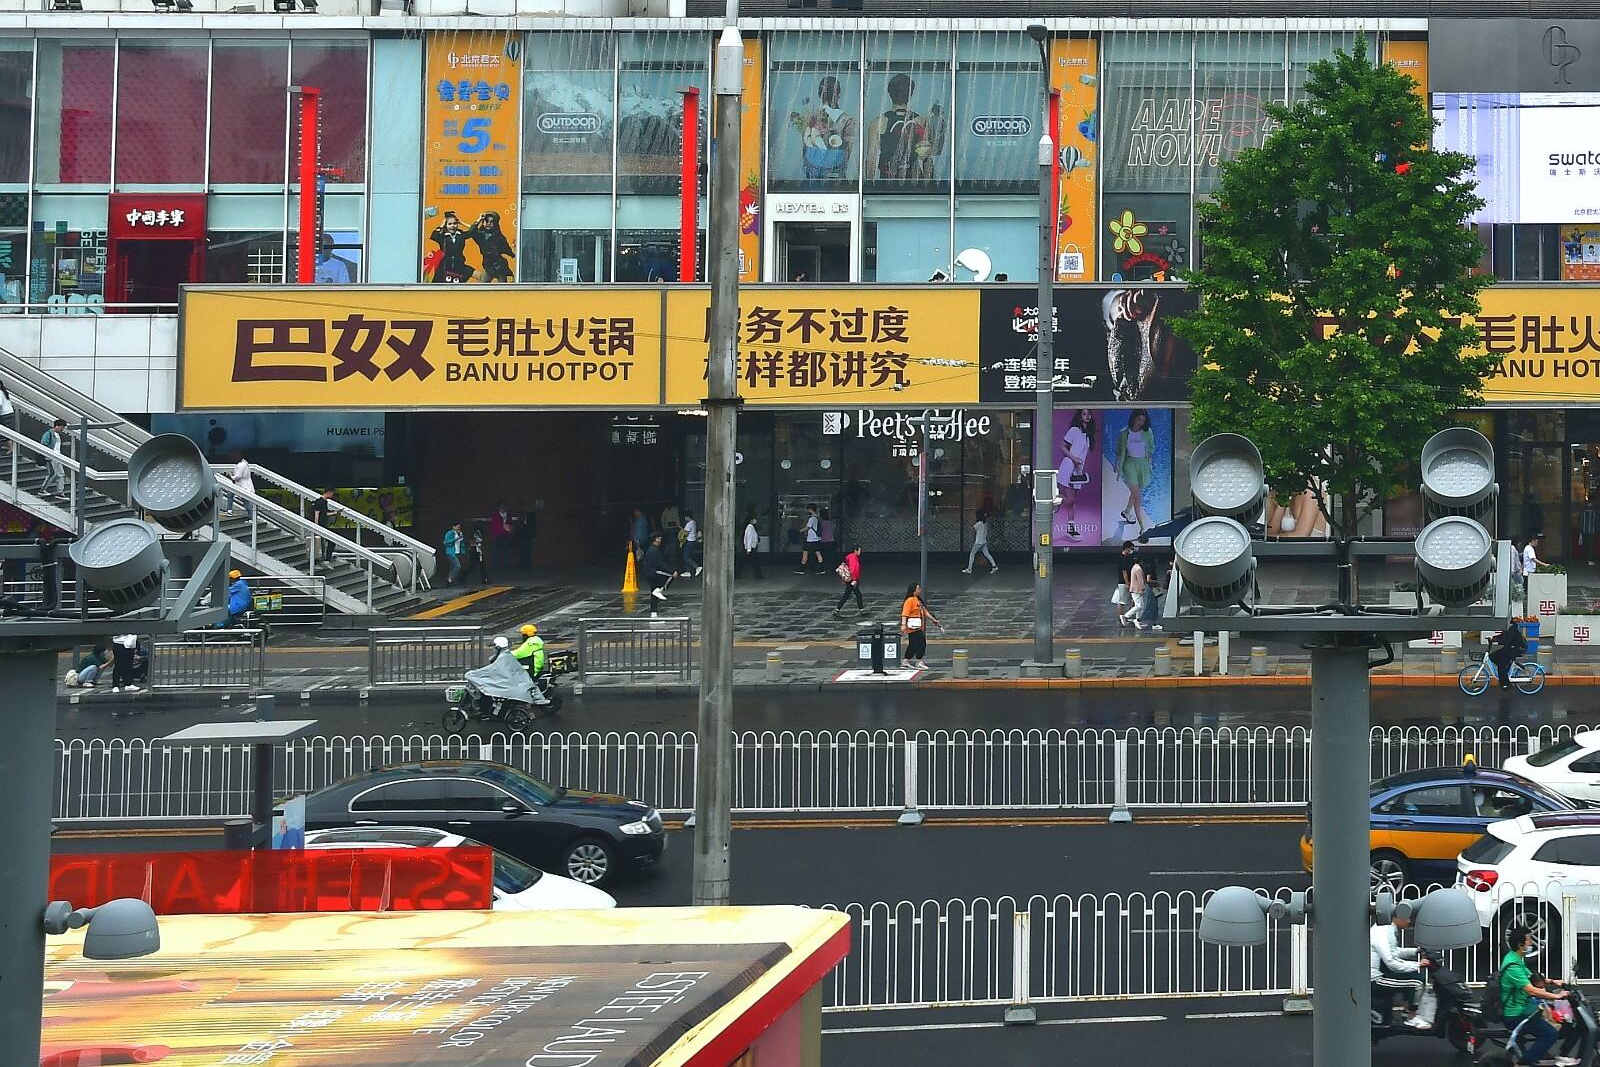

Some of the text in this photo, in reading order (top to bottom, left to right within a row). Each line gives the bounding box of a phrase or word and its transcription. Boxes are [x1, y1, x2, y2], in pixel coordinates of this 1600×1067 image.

[541, 117, 596, 130] OUTDOOR
[1131, 98, 1223, 131] AAPE
[458, 117, 492, 153] 5
[974, 120, 1027, 133] OUTDOOR
[126, 209, 185, 226] 中国李宁
[776, 203, 825, 214] HEYTEA
[1023, 307, 1058, 316] 大众评
[446, 316, 635, 358] 毛肚火锅
[231, 314, 435, 383] 巴奴
[446, 360, 634, 383] BANU HOTPOT
[1004, 358, 1070, 372] 连续年
[1480, 360, 1545, 379] ANU
[326, 427, 370, 436] HUAWEI
[857, 409, 916, 440] Peet's
[920, 408, 991, 442] Cffee
[1055, 524, 1098, 533] ACEBIRD
[437, 1014, 512, 1048] COLOR
